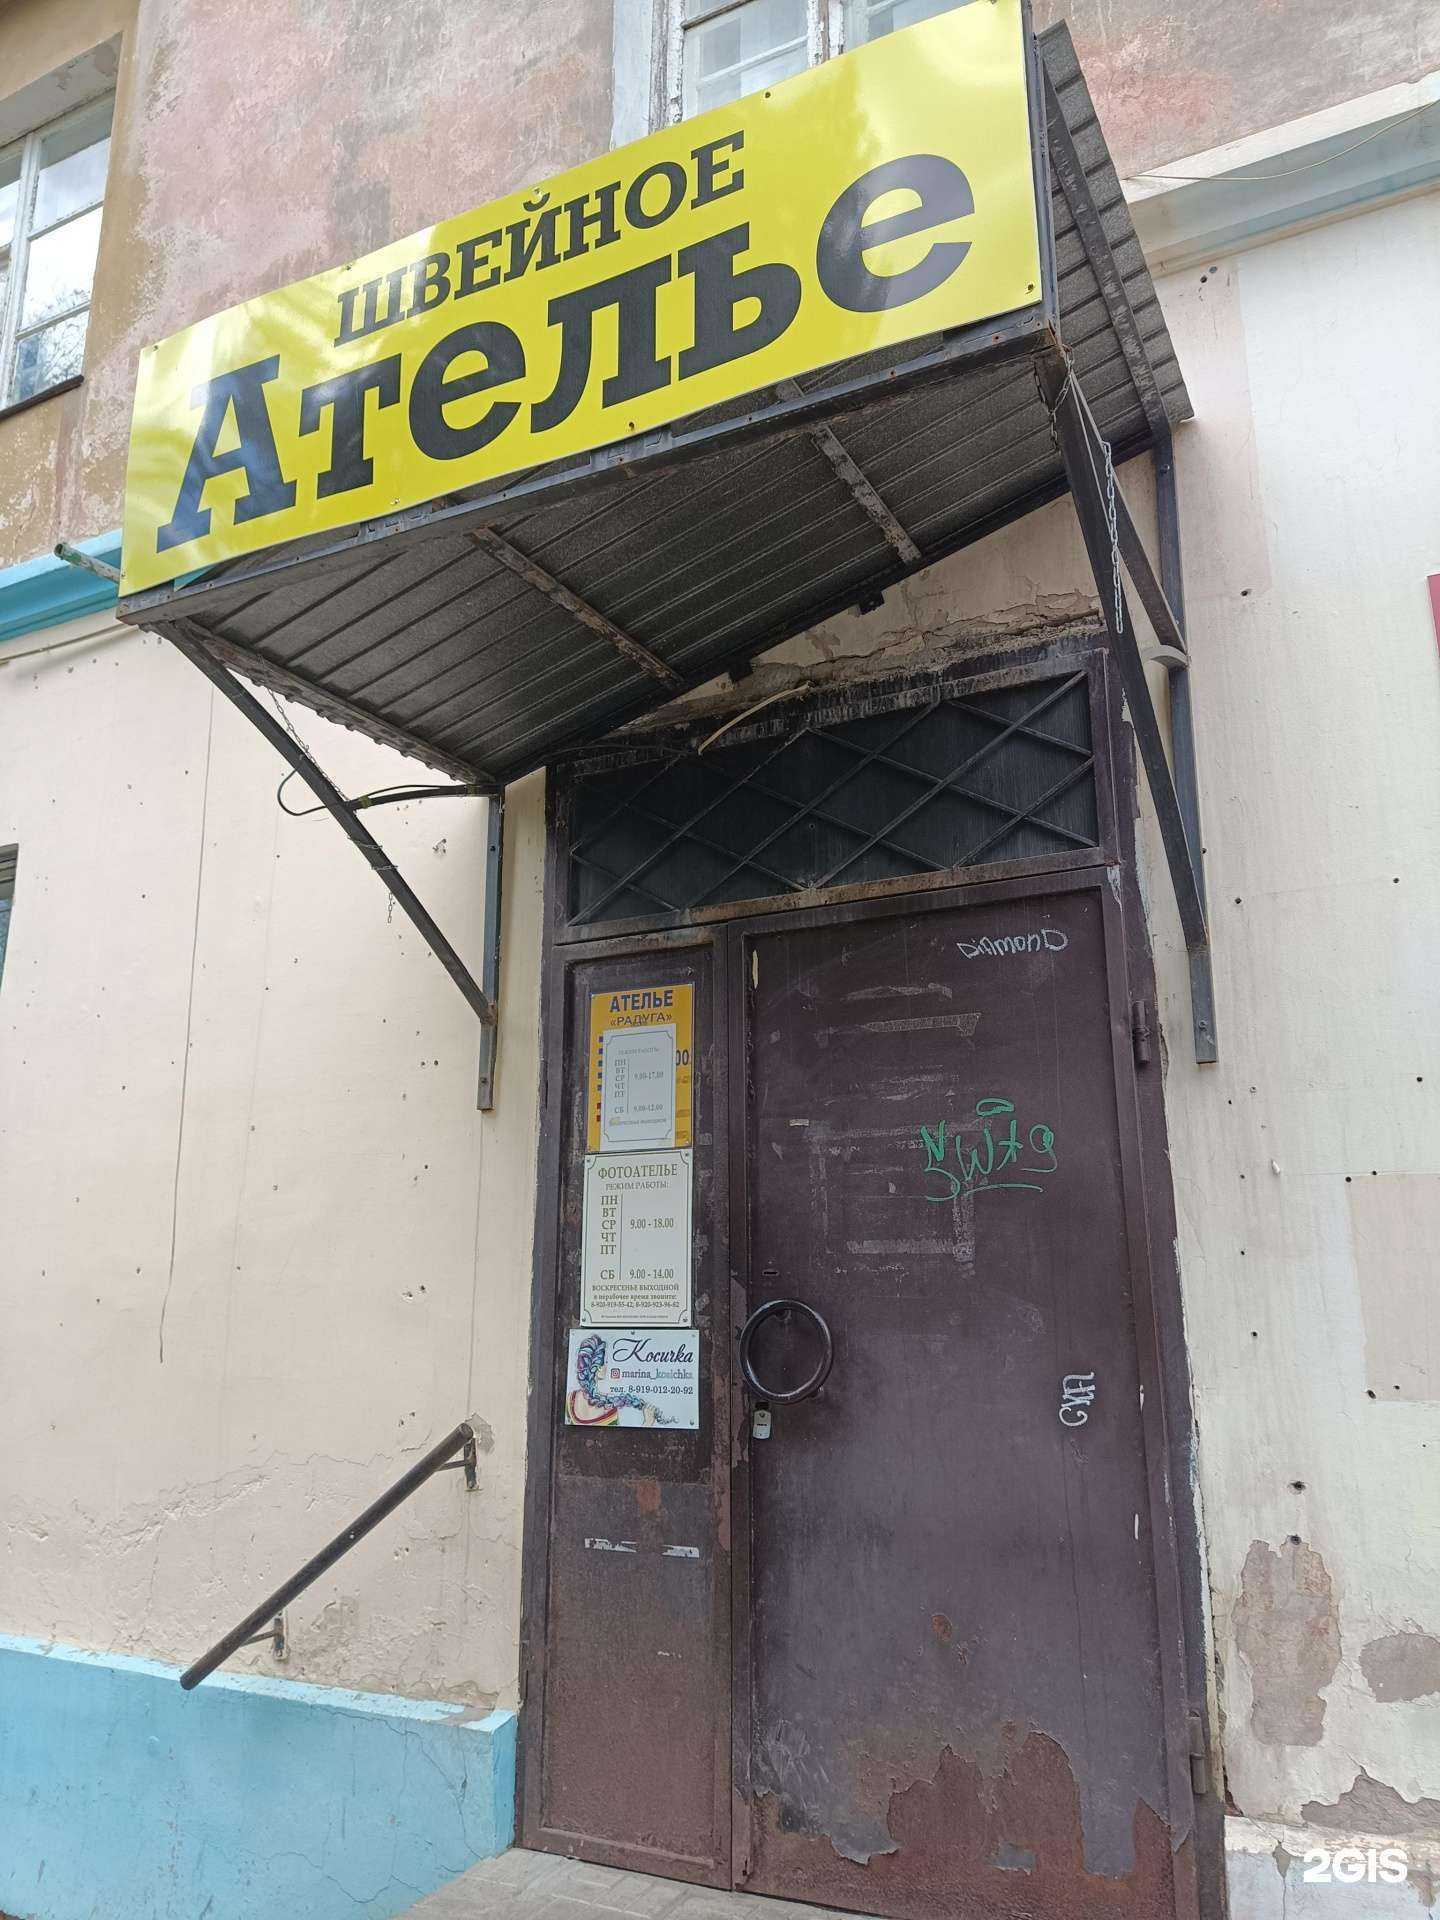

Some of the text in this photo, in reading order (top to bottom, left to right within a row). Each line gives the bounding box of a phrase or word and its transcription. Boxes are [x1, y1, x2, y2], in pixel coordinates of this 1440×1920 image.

[333, 129, 745, 348] ШВЕЙНОЕ
[156, 152, 976, 553] Ателье
[609, 989, 674, 1013] АТЕЛЬЕ
[610, 1011, 673, 1027] «РАДУГА»
[598, 1163, 678, 1179] ФОТОАТЕЛЬЕ
[605, 1180, 669, 1191] РЕЖИМ РАБОТЫ:
[600, 1195, 618, 1206] ПН
[602, 1207, 617, 1218] ВТ
[601, 1219, 616, 1230] СР
[629, 1218, 647, 1230] 9.00
[653, 1217, 674, 1229] 18.00
[600, 1231, 617, 1242] ЧТ
[600, 1244, 616, 1255] ПТ
[600, 1269, 615, 1280] СБ
[629, 1268, 647, 1280] 9.00
[653, 1268, 674, 1279] 14.00
[592, 1283, 679, 1292] ВОСКРЕСЕНЬЕ ВЫХОДНОЙ
[609, 1385, 694, 1395] тел. 8-919-012-20-92
